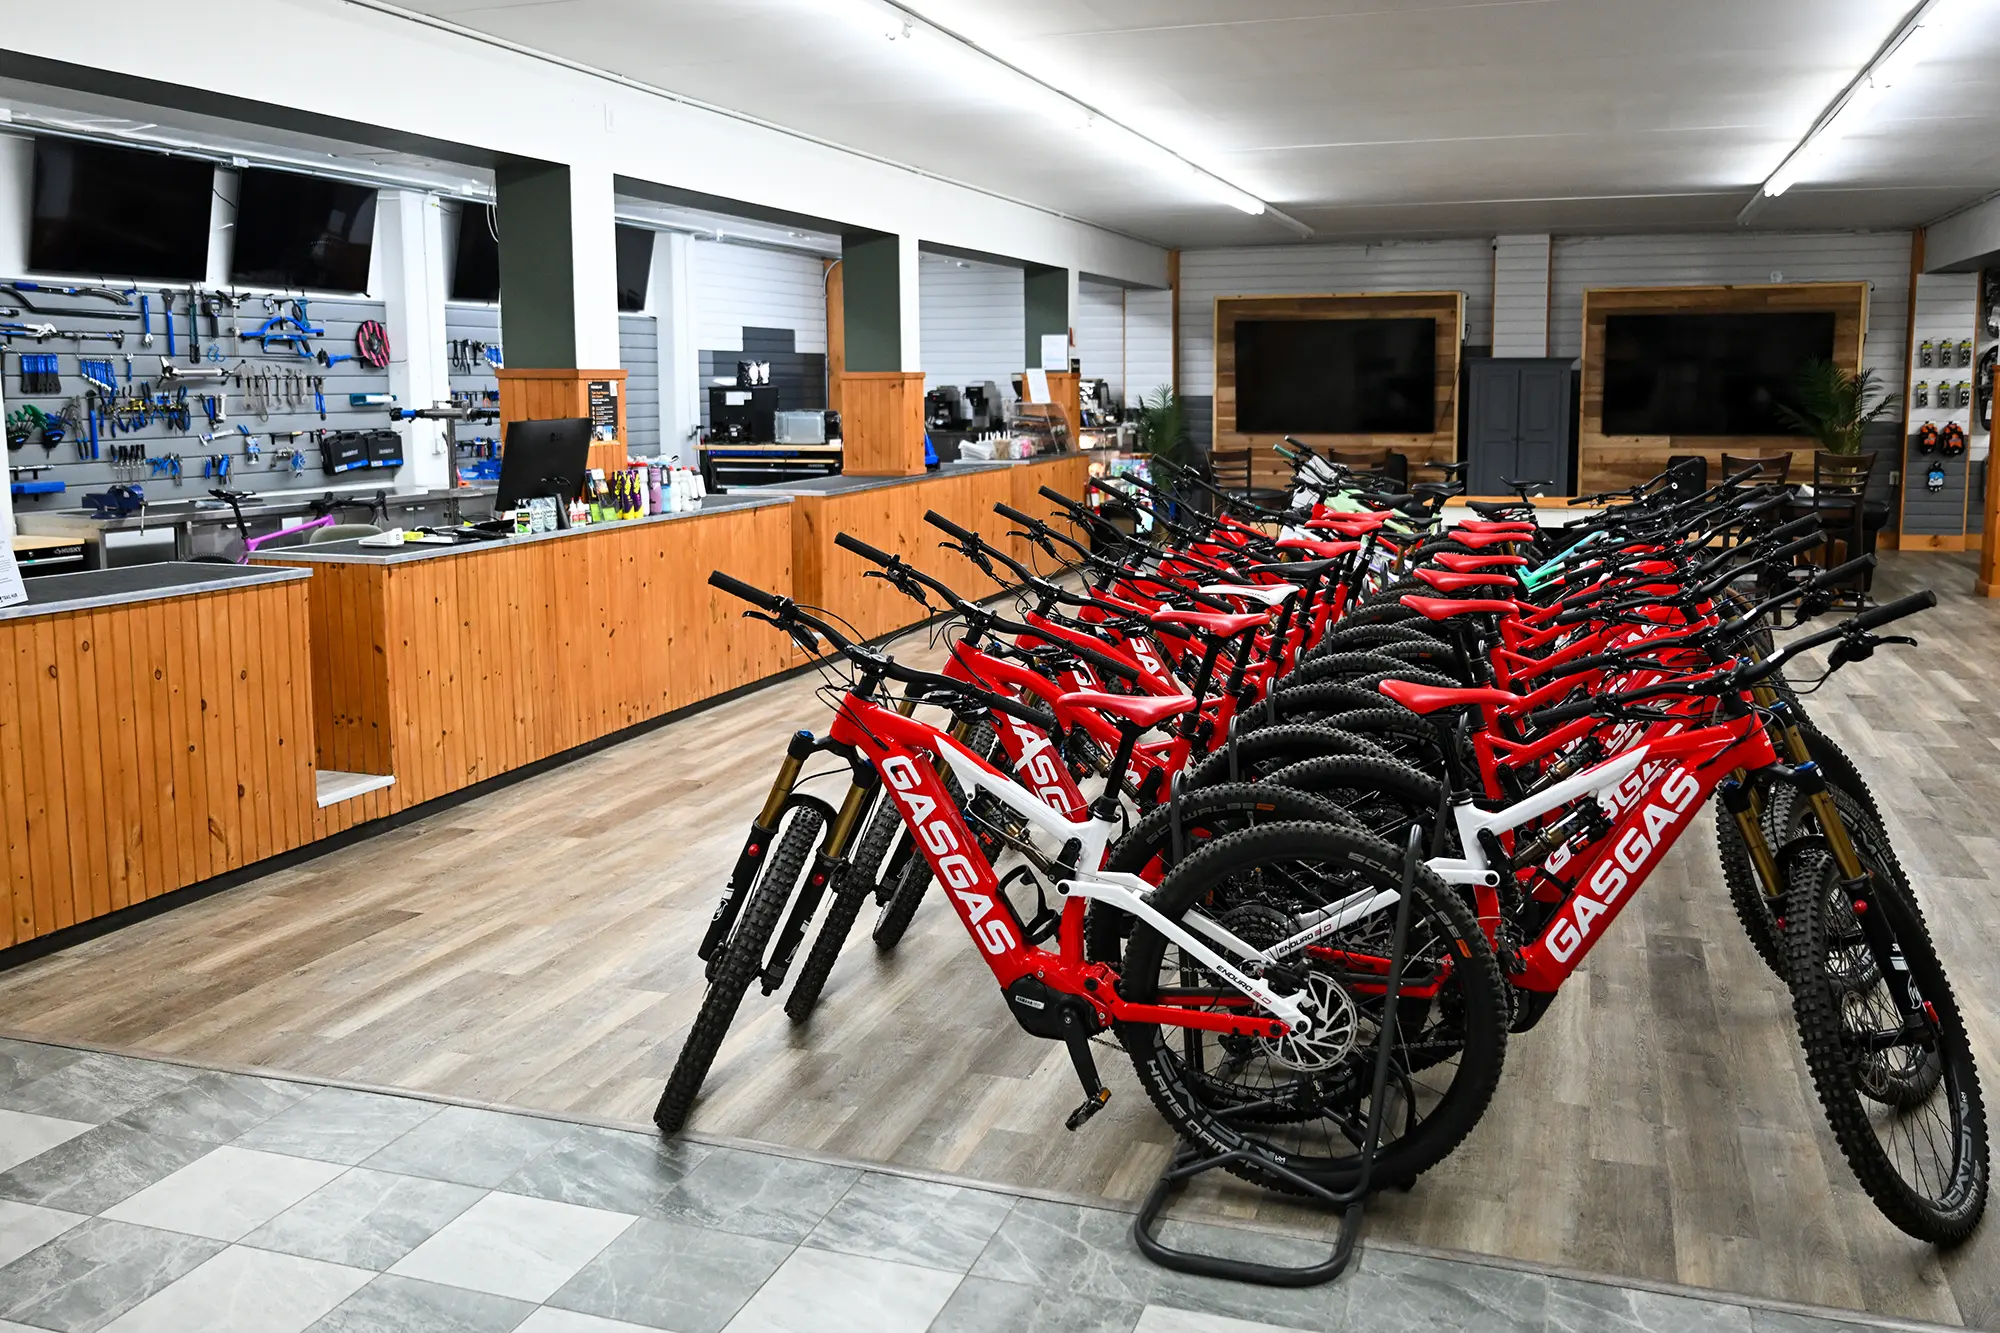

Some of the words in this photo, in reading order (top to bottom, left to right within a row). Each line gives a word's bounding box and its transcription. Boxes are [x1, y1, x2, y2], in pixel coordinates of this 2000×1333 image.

[61, 546, 82, 554] HUSKY
[1146, 802, 1256, 845] SCWALBE
[882, 754, 1016, 955] GASGAS
[1545, 767, 1700, 963] GASGAS
[1279, 932, 1314, 954] ENDURO
[1216, 964, 1253, 992] ENDURO
[1251, 988, 1272, 1005] 3.0
[1146, 1059, 1187, 1119] HANS
